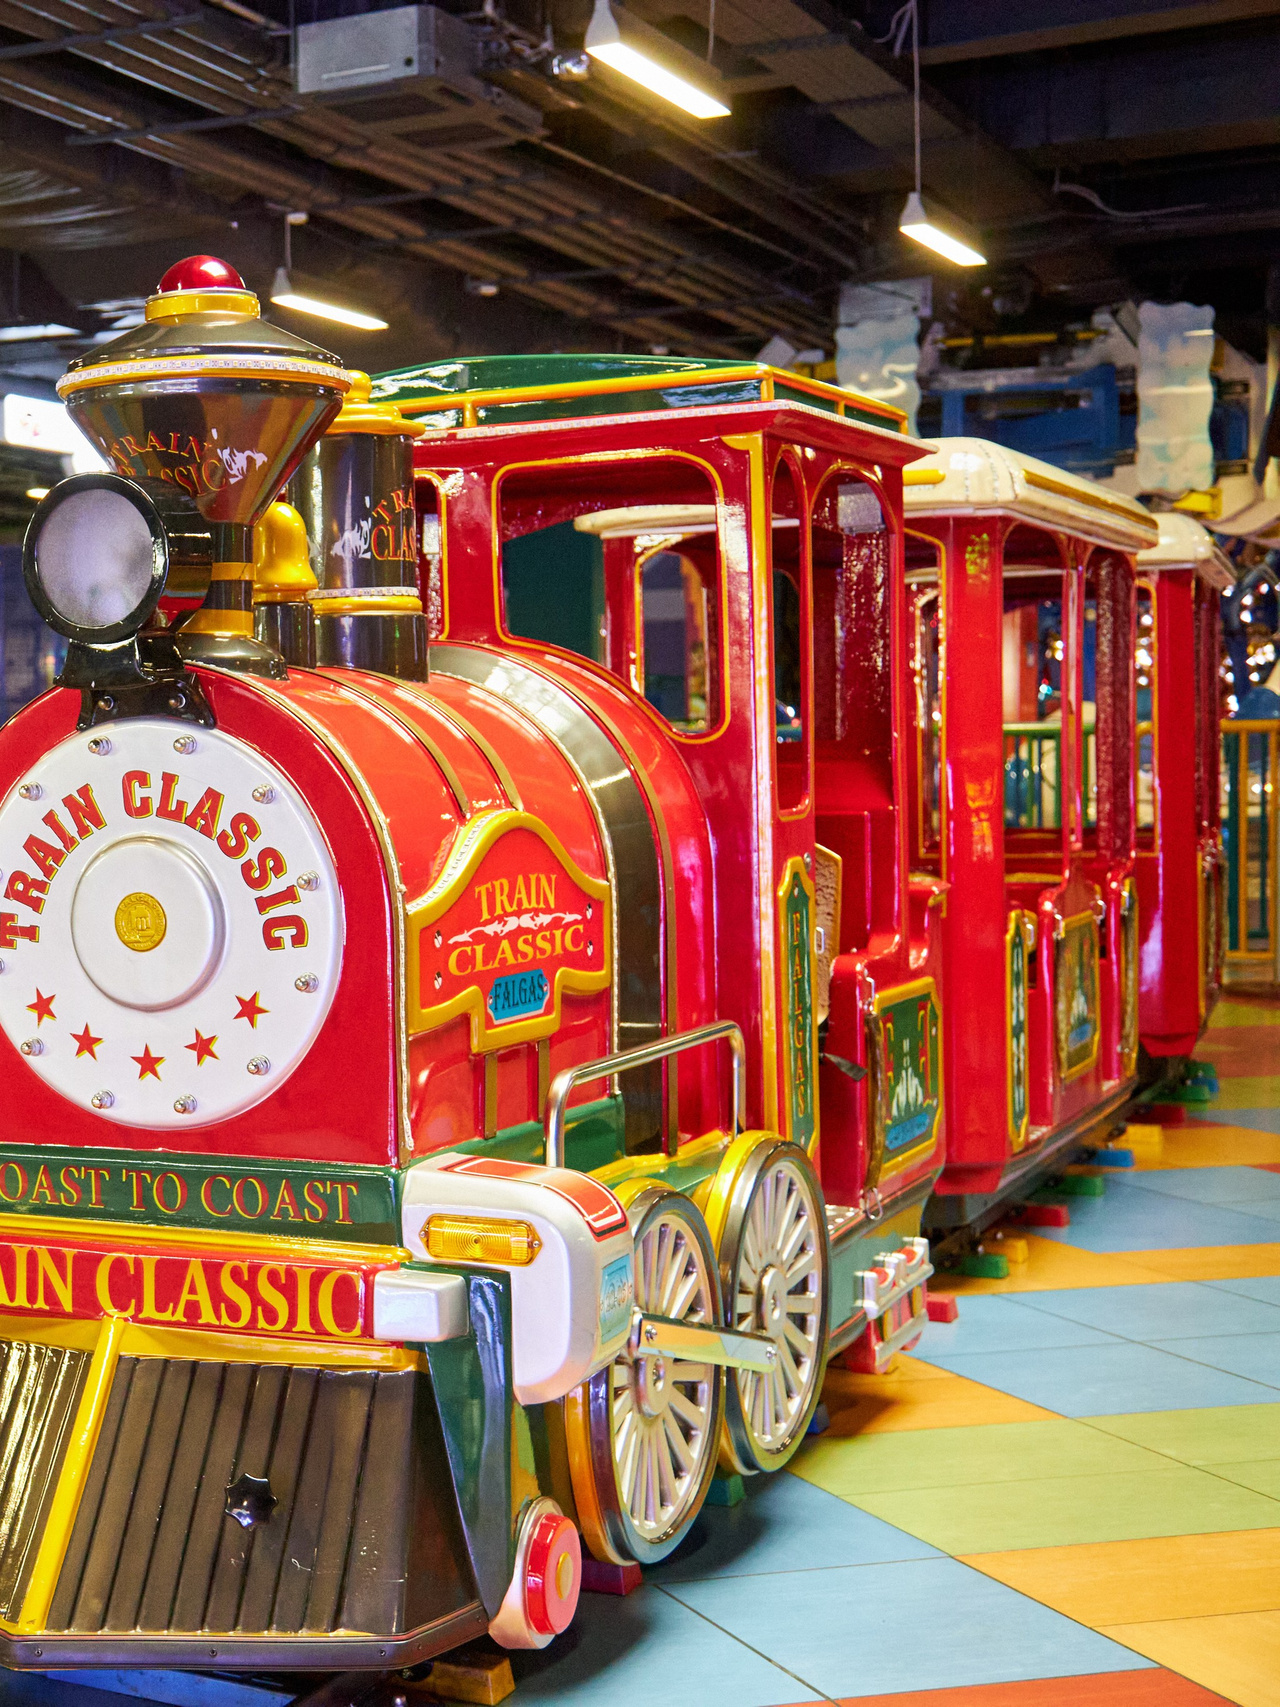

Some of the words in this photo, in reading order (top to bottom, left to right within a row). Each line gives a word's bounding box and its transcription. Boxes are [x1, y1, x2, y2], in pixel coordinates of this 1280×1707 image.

[110, 430, 212, 466] TRAIN
[117, 460, 227, 497] SSIC
[372, 488, 415, 524] TRA
[371, 524, 417, 562] CLAS
[122, 770, 309, 951] CLASSIC
[475, 873, 556, 922] TRAIN
[448, 925, 584, 976] CLASSIC
[494, 974, 544, 1011] FALGAS
[792, 911, 804, 1118] FALGAS
[122, 1168, 188, 1214] TO
[201, 1174, 359, 1225] COAST
[95, 1252, 362, 1338] CLASSIC
